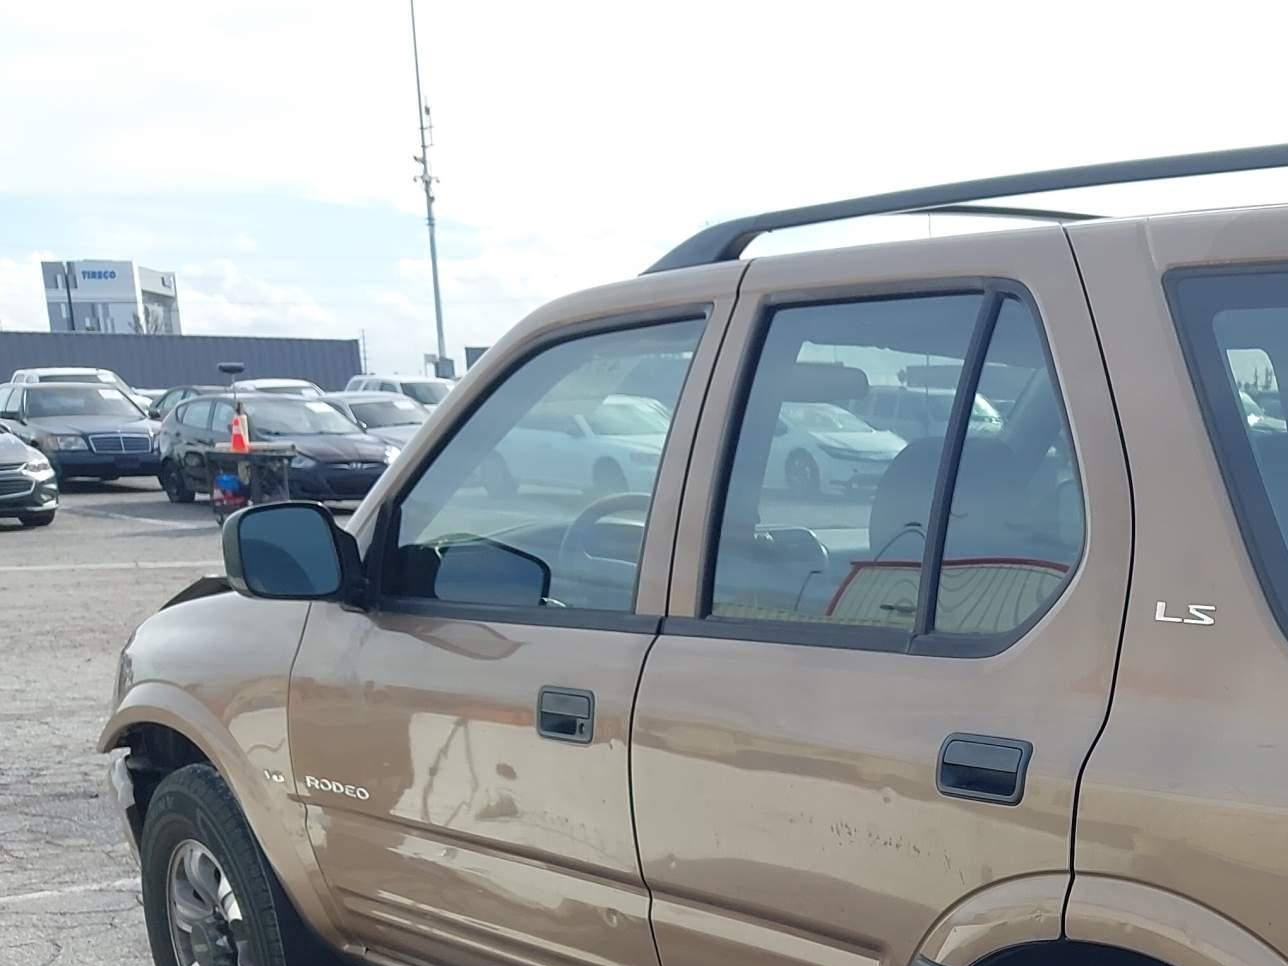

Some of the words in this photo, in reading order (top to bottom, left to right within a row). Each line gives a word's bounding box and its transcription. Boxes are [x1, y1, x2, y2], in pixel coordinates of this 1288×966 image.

[81, 270, 118, 280] TIRECO
[1155, 600, 1217, 626] LS
[305, 775, 370, 801] RODEO
